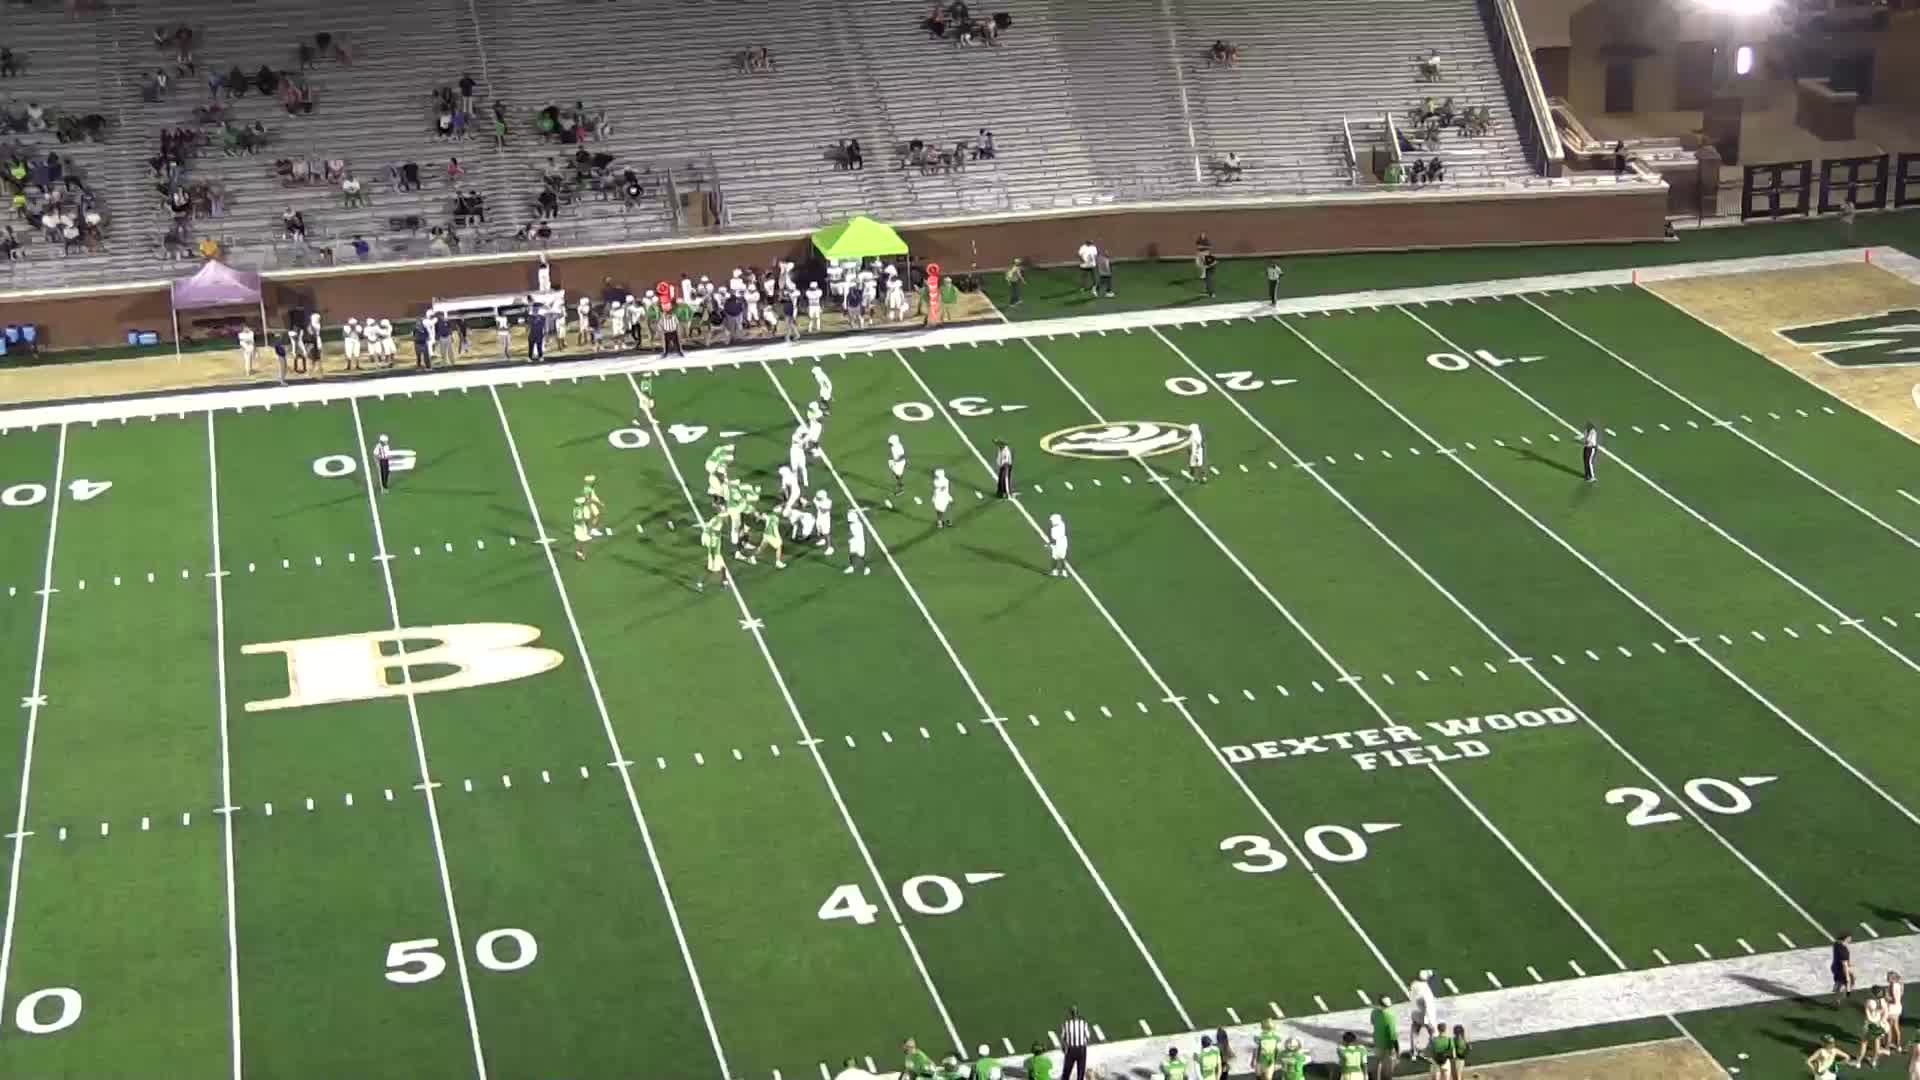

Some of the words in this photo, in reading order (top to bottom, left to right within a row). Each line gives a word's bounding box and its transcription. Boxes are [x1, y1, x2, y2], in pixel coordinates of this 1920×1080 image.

[1426, 349, 1515, 371] 10
[1165, 370, 1265, 396] 20
[892, 396, 994, 422] 30
[607, 423, 709, 449] 40
[0, 478, 113, 506] 40
[241, 622, 564, 712] B
[1220, 724, 1422, 764] DEXTER
[1426, 707, 1578, 737] WOOD
[1351, 740, 1491, 771] FIELD
[1605, 777, 1752, 827] 20
[1220, 825, 1368, 873] 30
[817, 874, 964, 925] 40
[385, 928, 538, 984] 50
